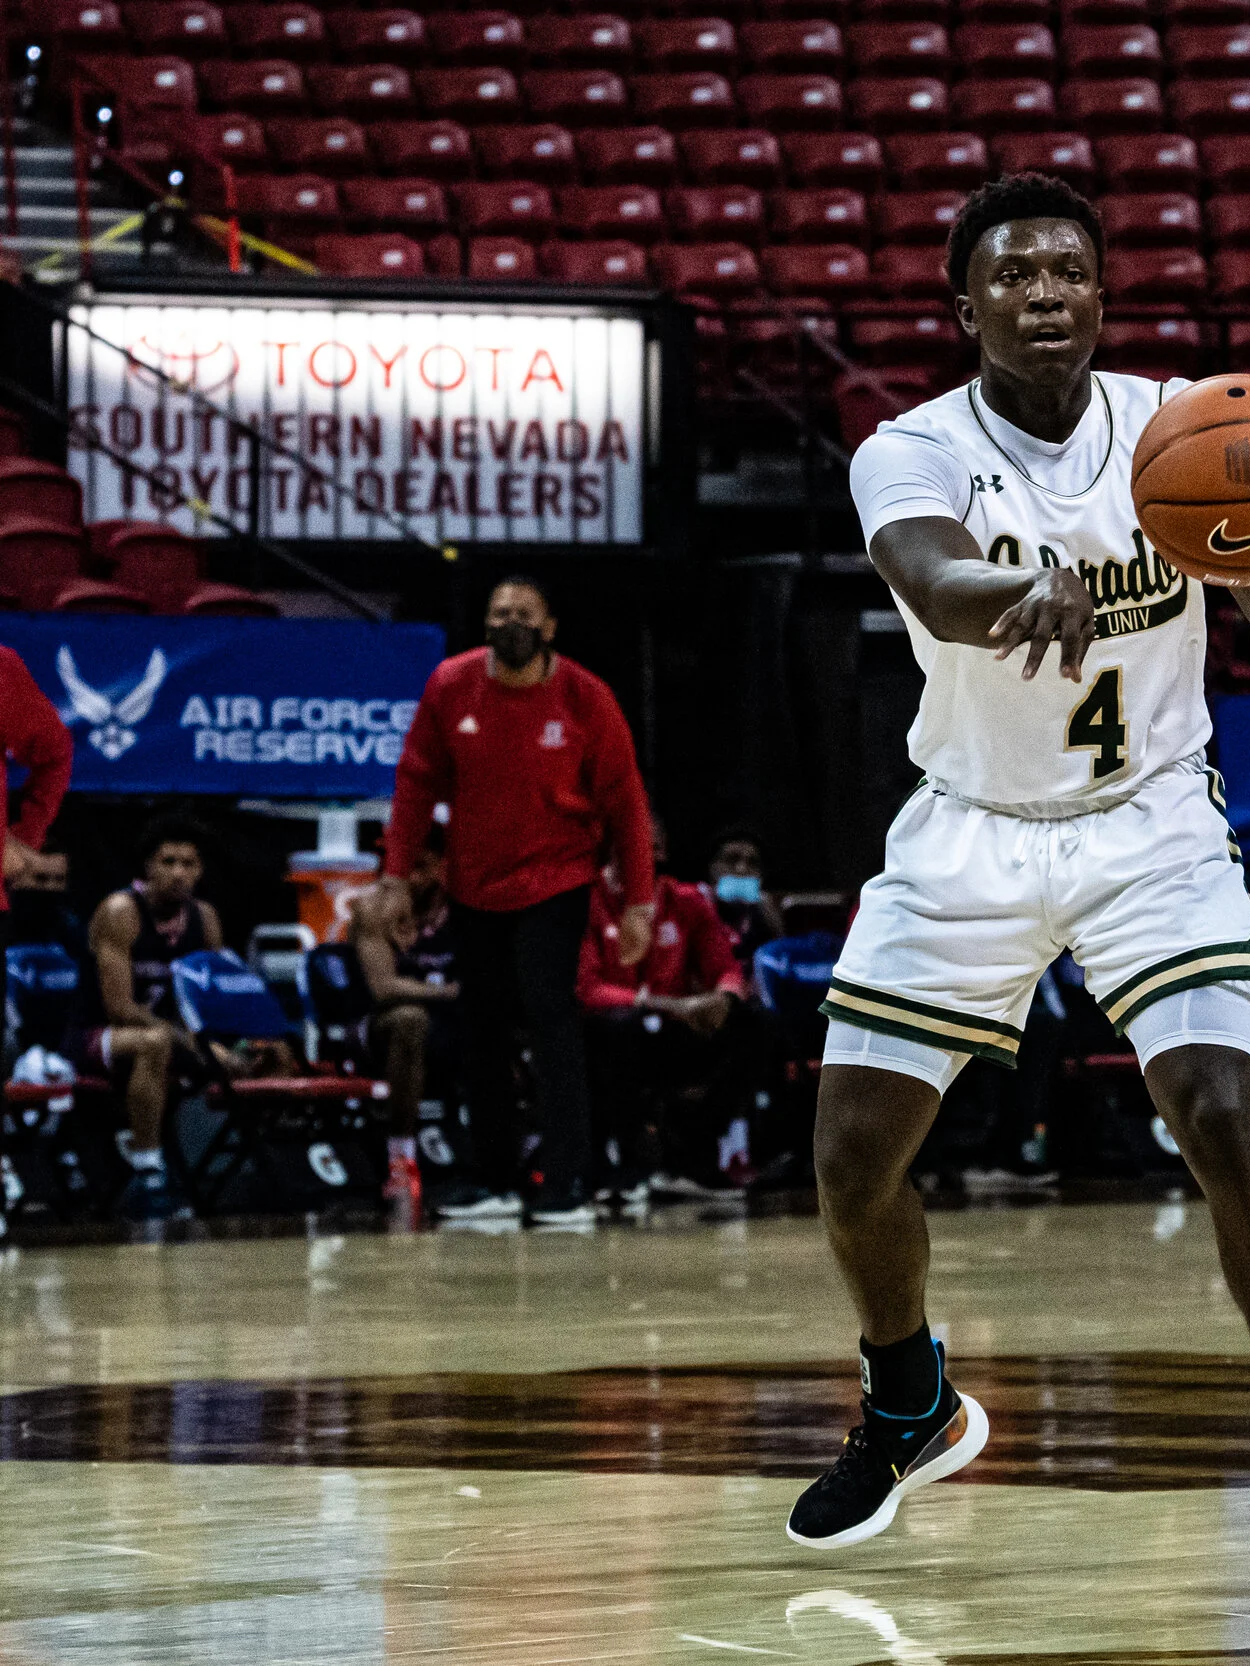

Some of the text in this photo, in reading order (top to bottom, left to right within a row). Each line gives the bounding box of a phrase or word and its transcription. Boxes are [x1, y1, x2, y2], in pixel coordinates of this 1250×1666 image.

[261, 340, 565, 392] TOYOTA
[410, 414, 629, 464] NEVADA
[354, 467, 602, 520] DEALERS
[987, 527, 1178, 609] rado
[1106, 606, 1151, 636] UNIV
[179, 694, 263, 729] AIR
[1063, 664, 1130, 783] 4
[194, 729, 405, 765] RESERVE
